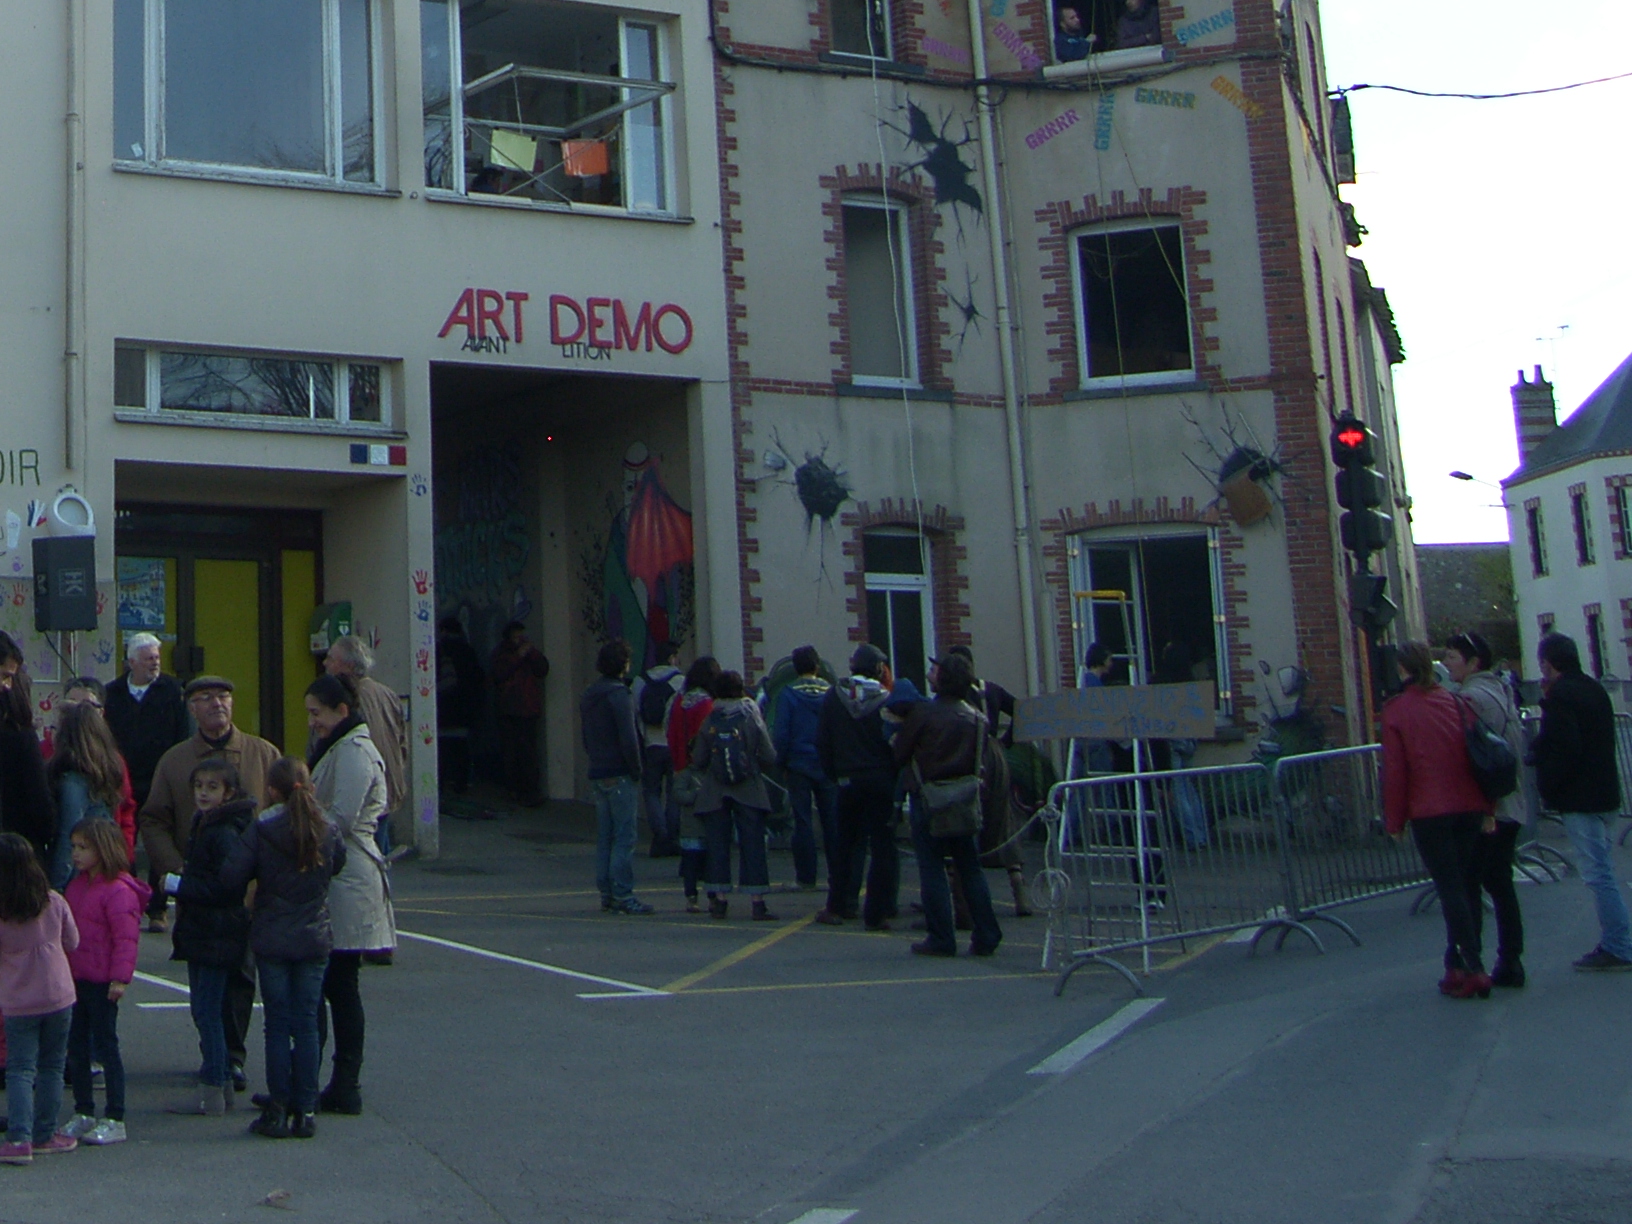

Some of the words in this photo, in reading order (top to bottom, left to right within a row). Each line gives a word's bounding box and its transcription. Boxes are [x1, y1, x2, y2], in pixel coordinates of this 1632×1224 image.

[1134, 86, 1198, 110] GRRRR
[1025, 108, 1080, 150] GRRRR
[437, 287, 529, 344] ART
[549, 294, 694, 355] DEMO
[461, 336, 509, 354] AVANT
[561, 341, 612, 361] LITION
